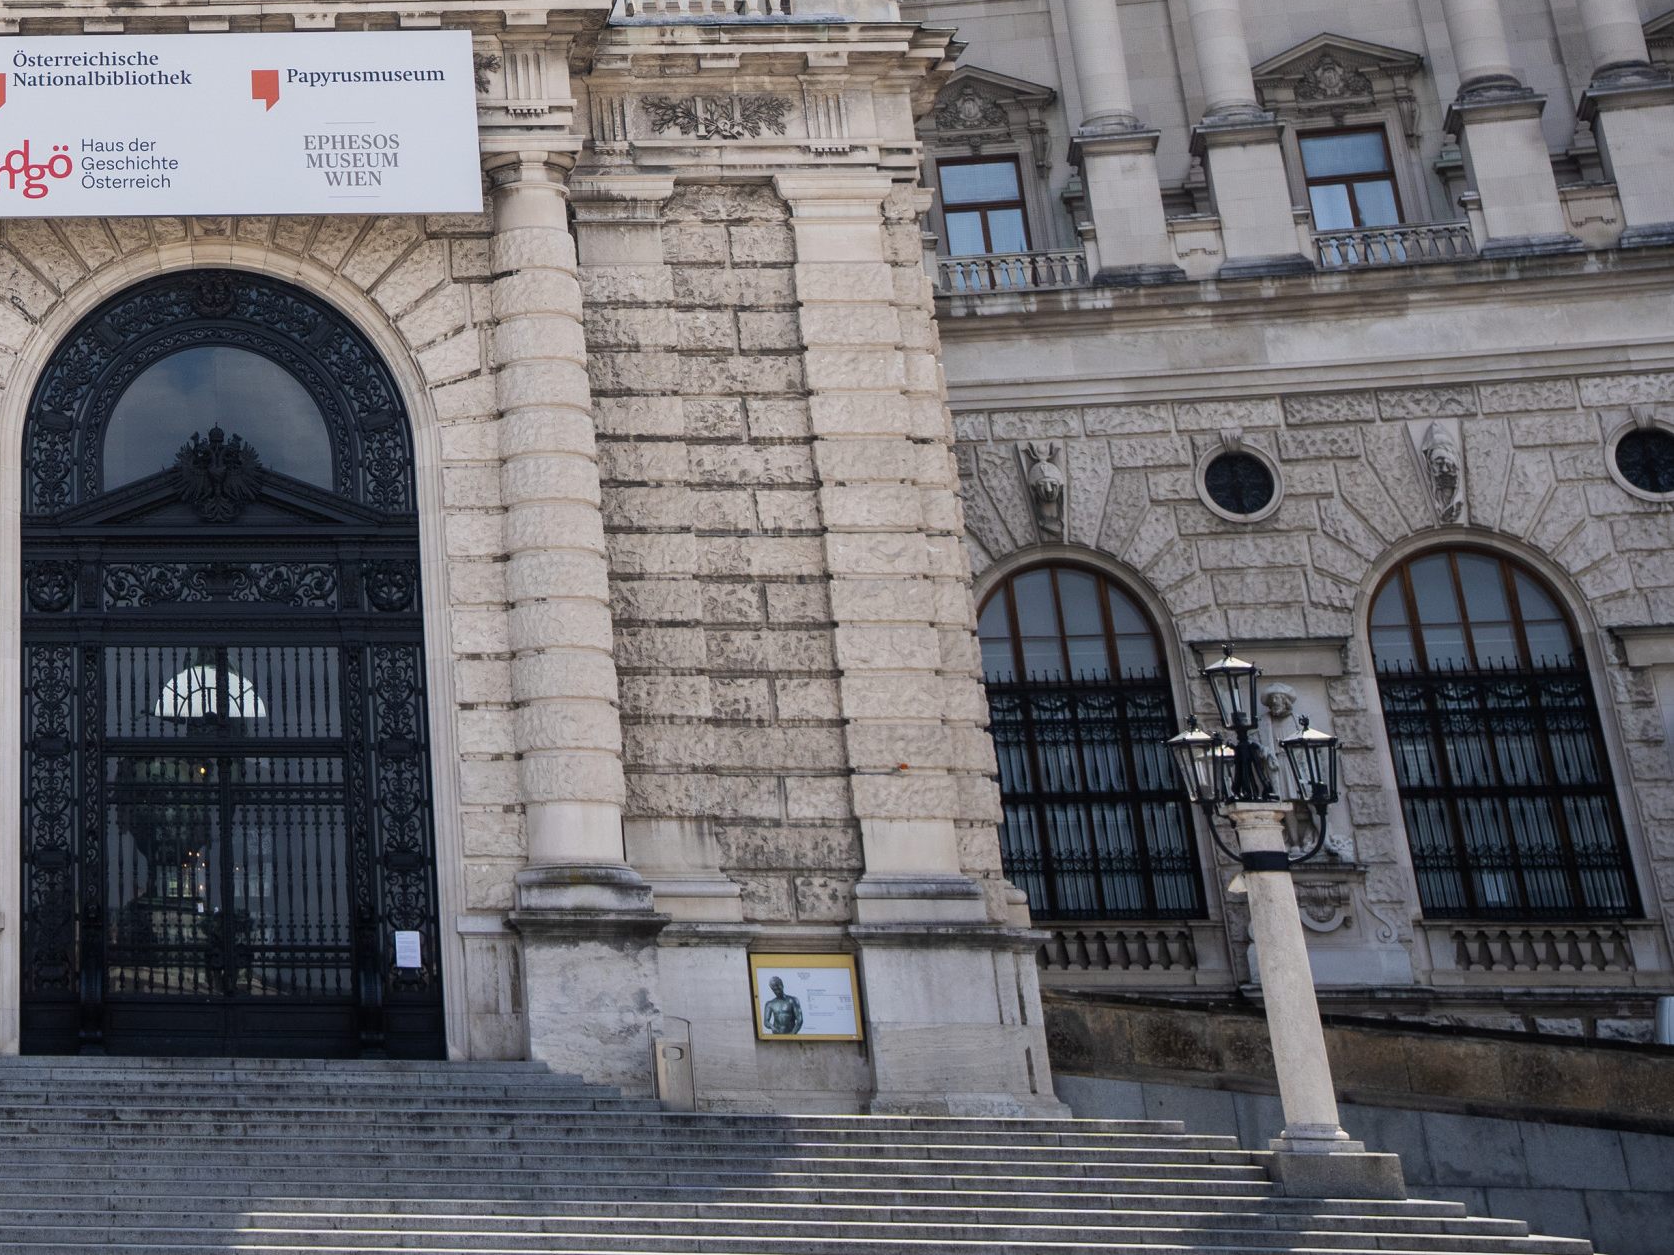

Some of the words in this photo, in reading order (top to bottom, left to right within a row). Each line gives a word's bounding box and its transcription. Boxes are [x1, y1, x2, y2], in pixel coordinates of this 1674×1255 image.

[13, 50, 159, 67] Österreichische
[13, 70, 192, 87] Nationalbibliothek
[286, 67, 445, 87] Papyrusmuseum
[81, 138, 124, 152] Haus
[128, 138, 157, 152] der
[303, 133, 400, 150] EPHESOS
[81, 156, 179, 171] Geschichte
[306, 152, 399, 169] MUSEUM
[81, 172, 171, 189] Österreich
[324, 170, 382, 187] WIEN
